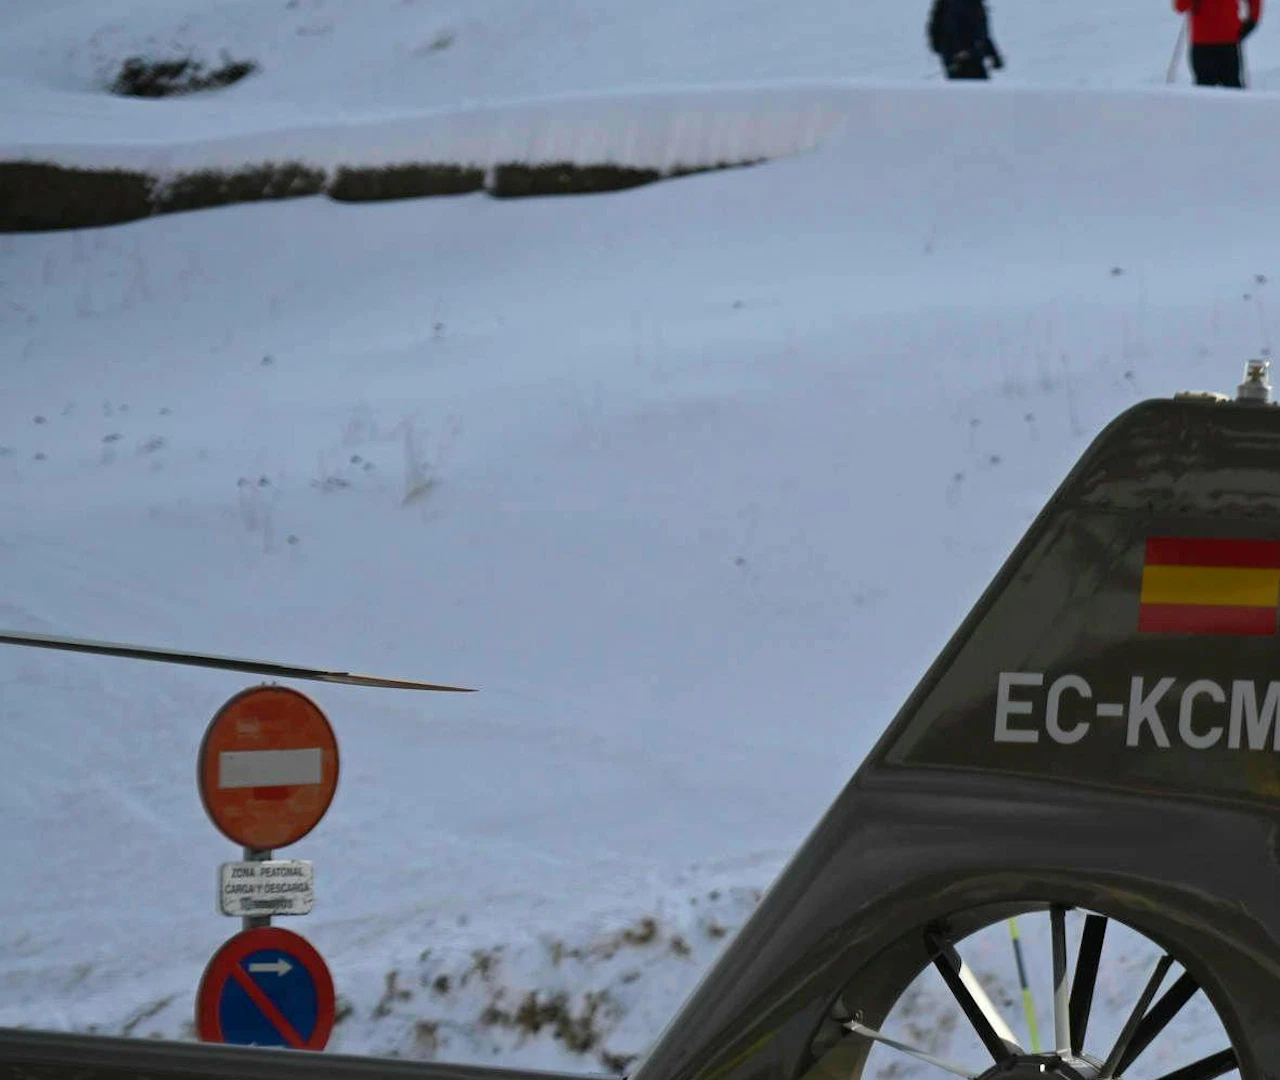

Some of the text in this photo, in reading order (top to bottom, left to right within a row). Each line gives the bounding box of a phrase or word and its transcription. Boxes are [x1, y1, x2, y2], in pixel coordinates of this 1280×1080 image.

[231, 866, 304, 878] ZONA PEATONAL
[225, 882, 309, 894] CARGA Y DESCARGA
